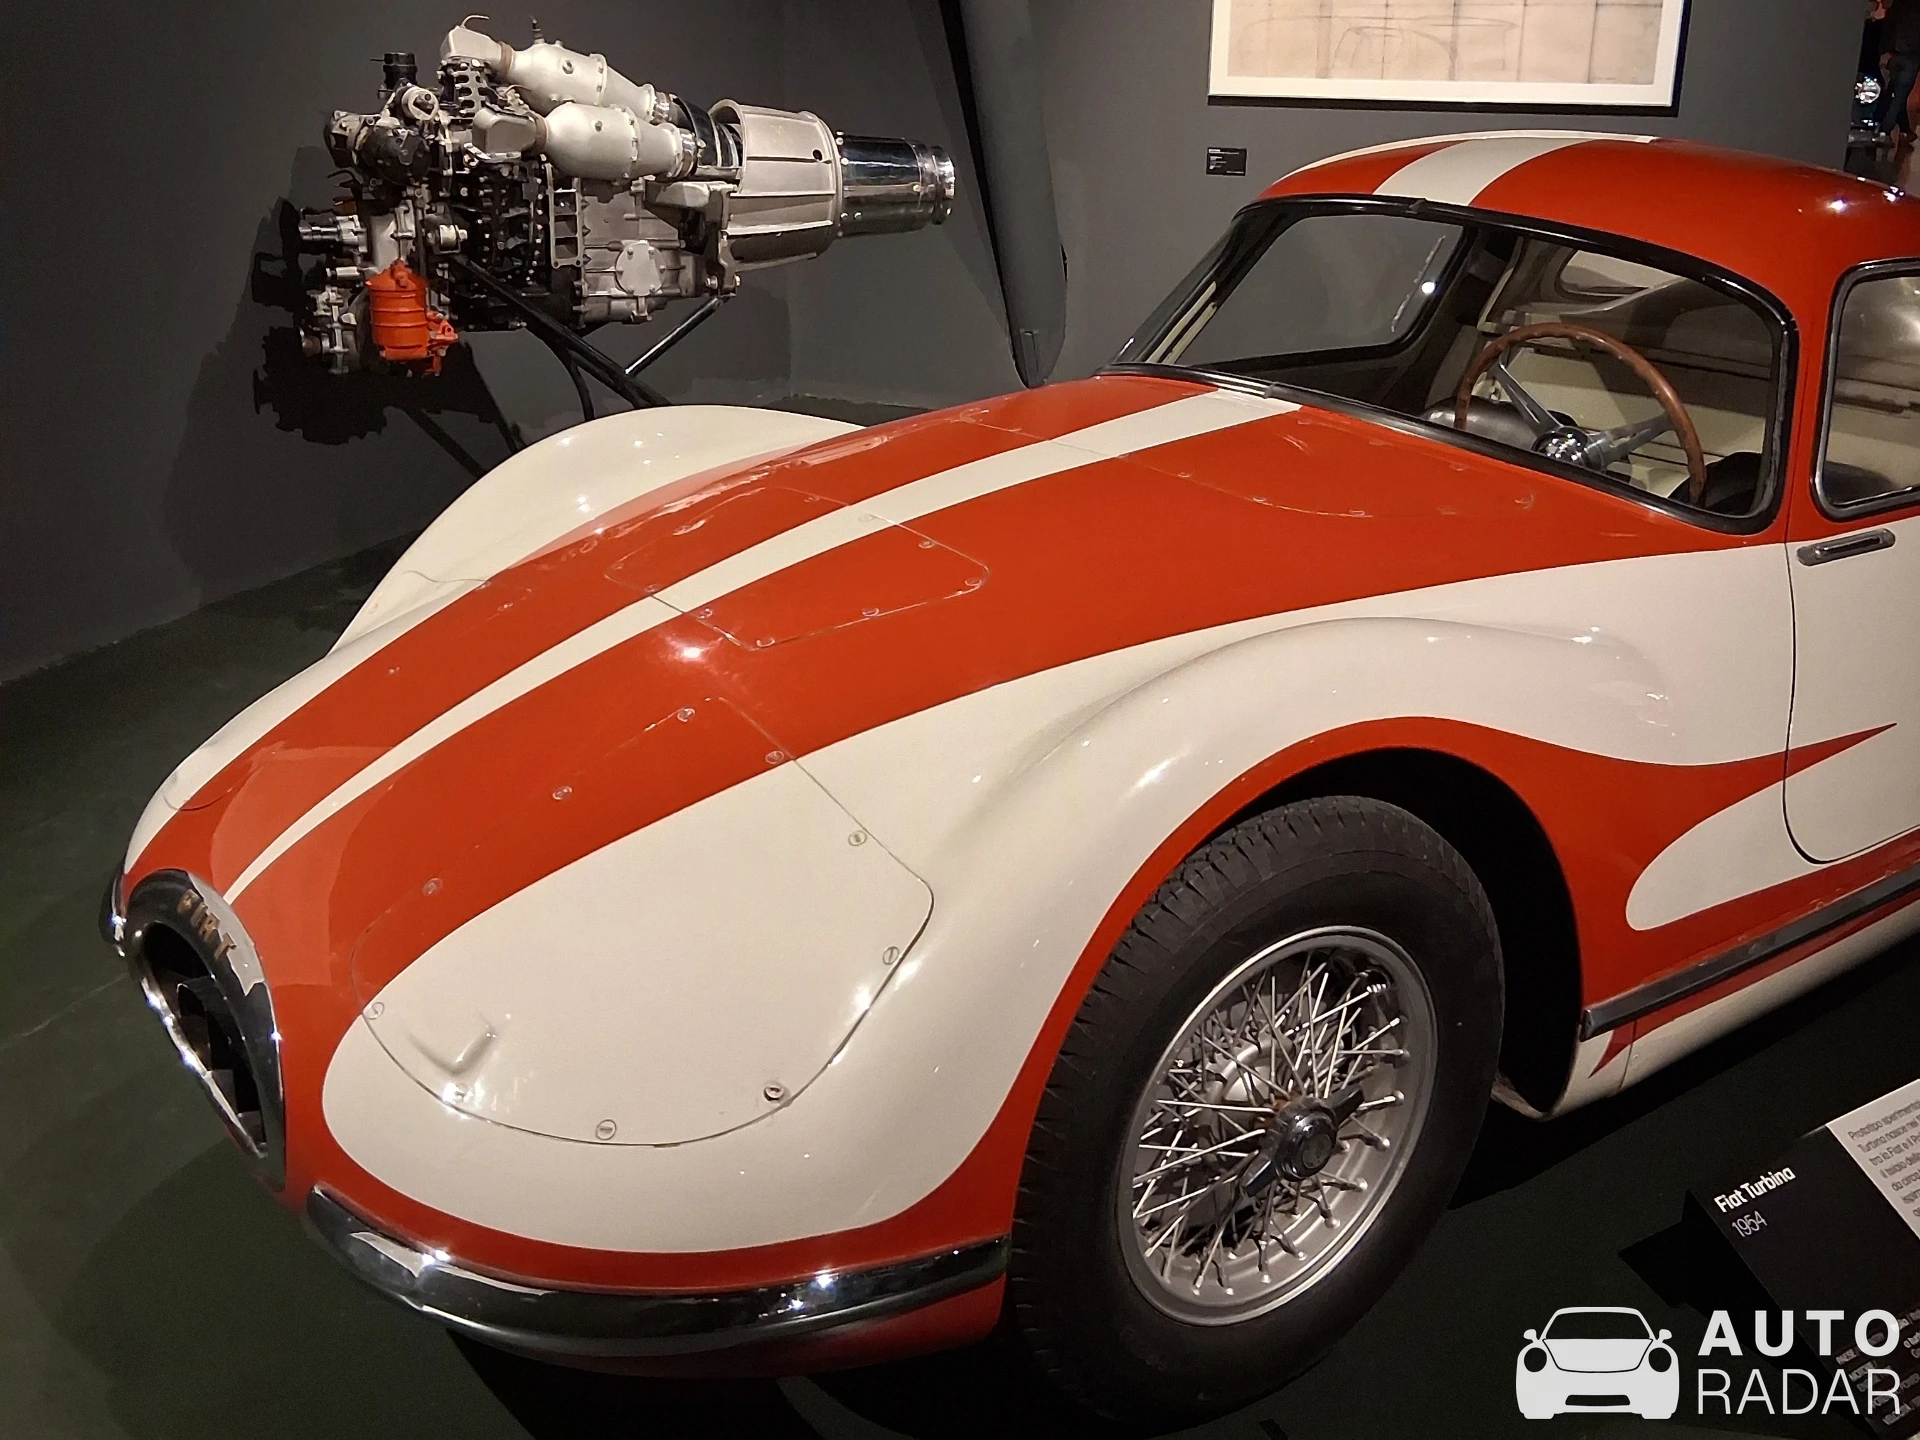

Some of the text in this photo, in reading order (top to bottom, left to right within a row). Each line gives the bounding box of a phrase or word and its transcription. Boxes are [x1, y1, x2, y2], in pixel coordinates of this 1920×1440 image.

[177, 889, 237, 960] FIAT
[1713, 1166, 1796, 1213] Fiat Turbina
[1731, 1210, 1768, 1238] 1954
